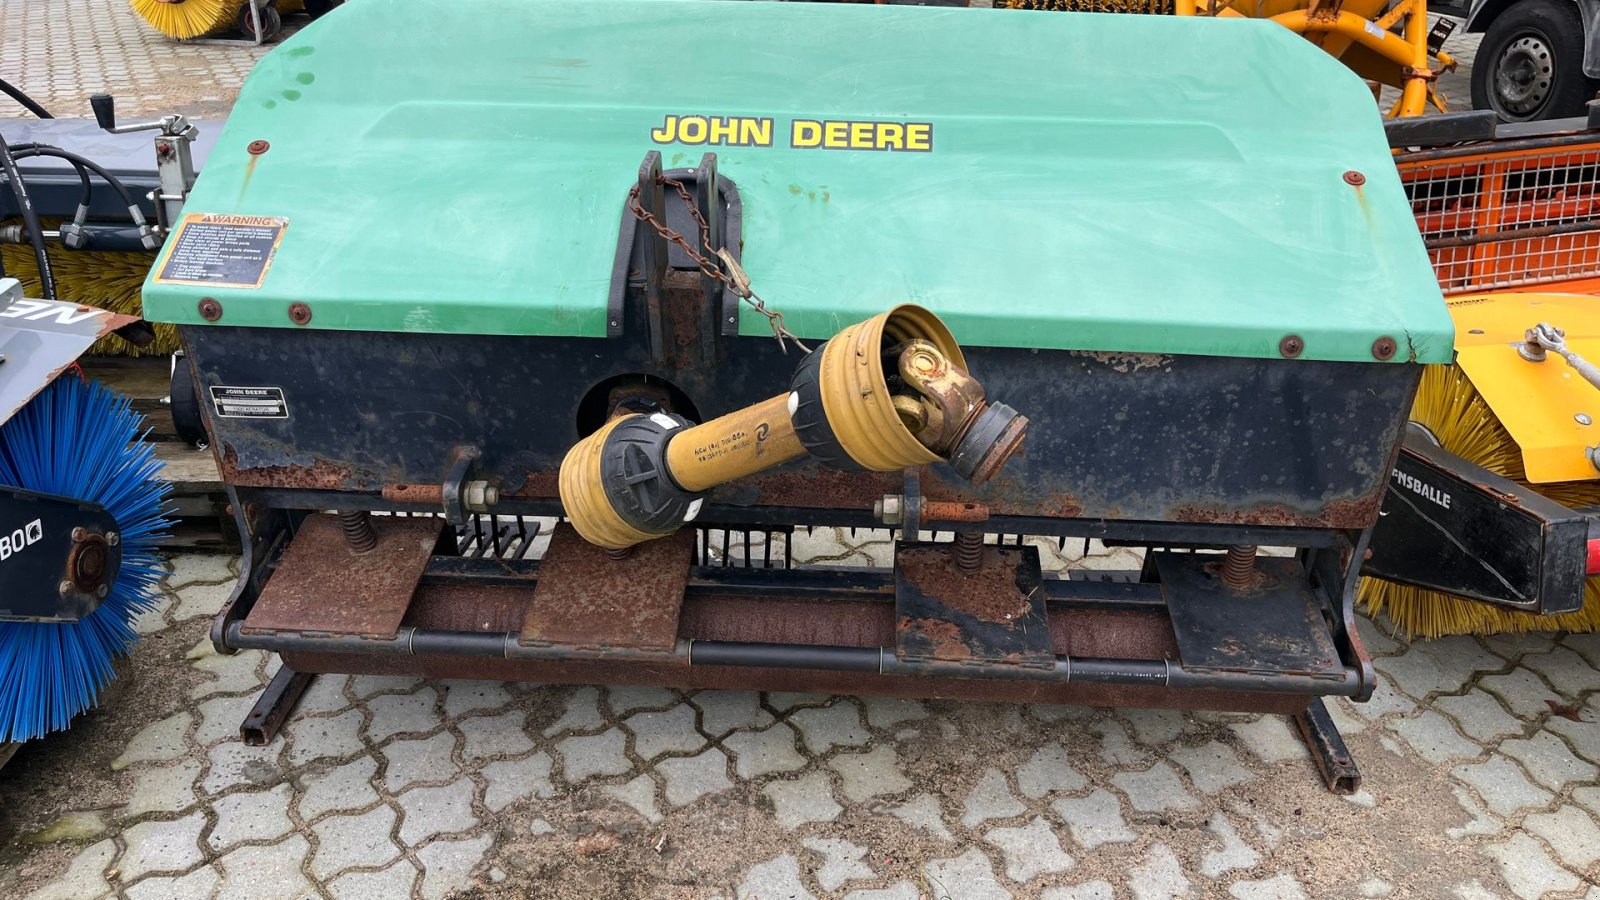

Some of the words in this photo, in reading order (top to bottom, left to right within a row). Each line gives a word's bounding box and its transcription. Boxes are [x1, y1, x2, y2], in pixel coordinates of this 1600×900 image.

[651, 115, 774, 147] JOHN
[790, 119, 932, 152] DEERE
[212, 216, 271, 225] WARNING
